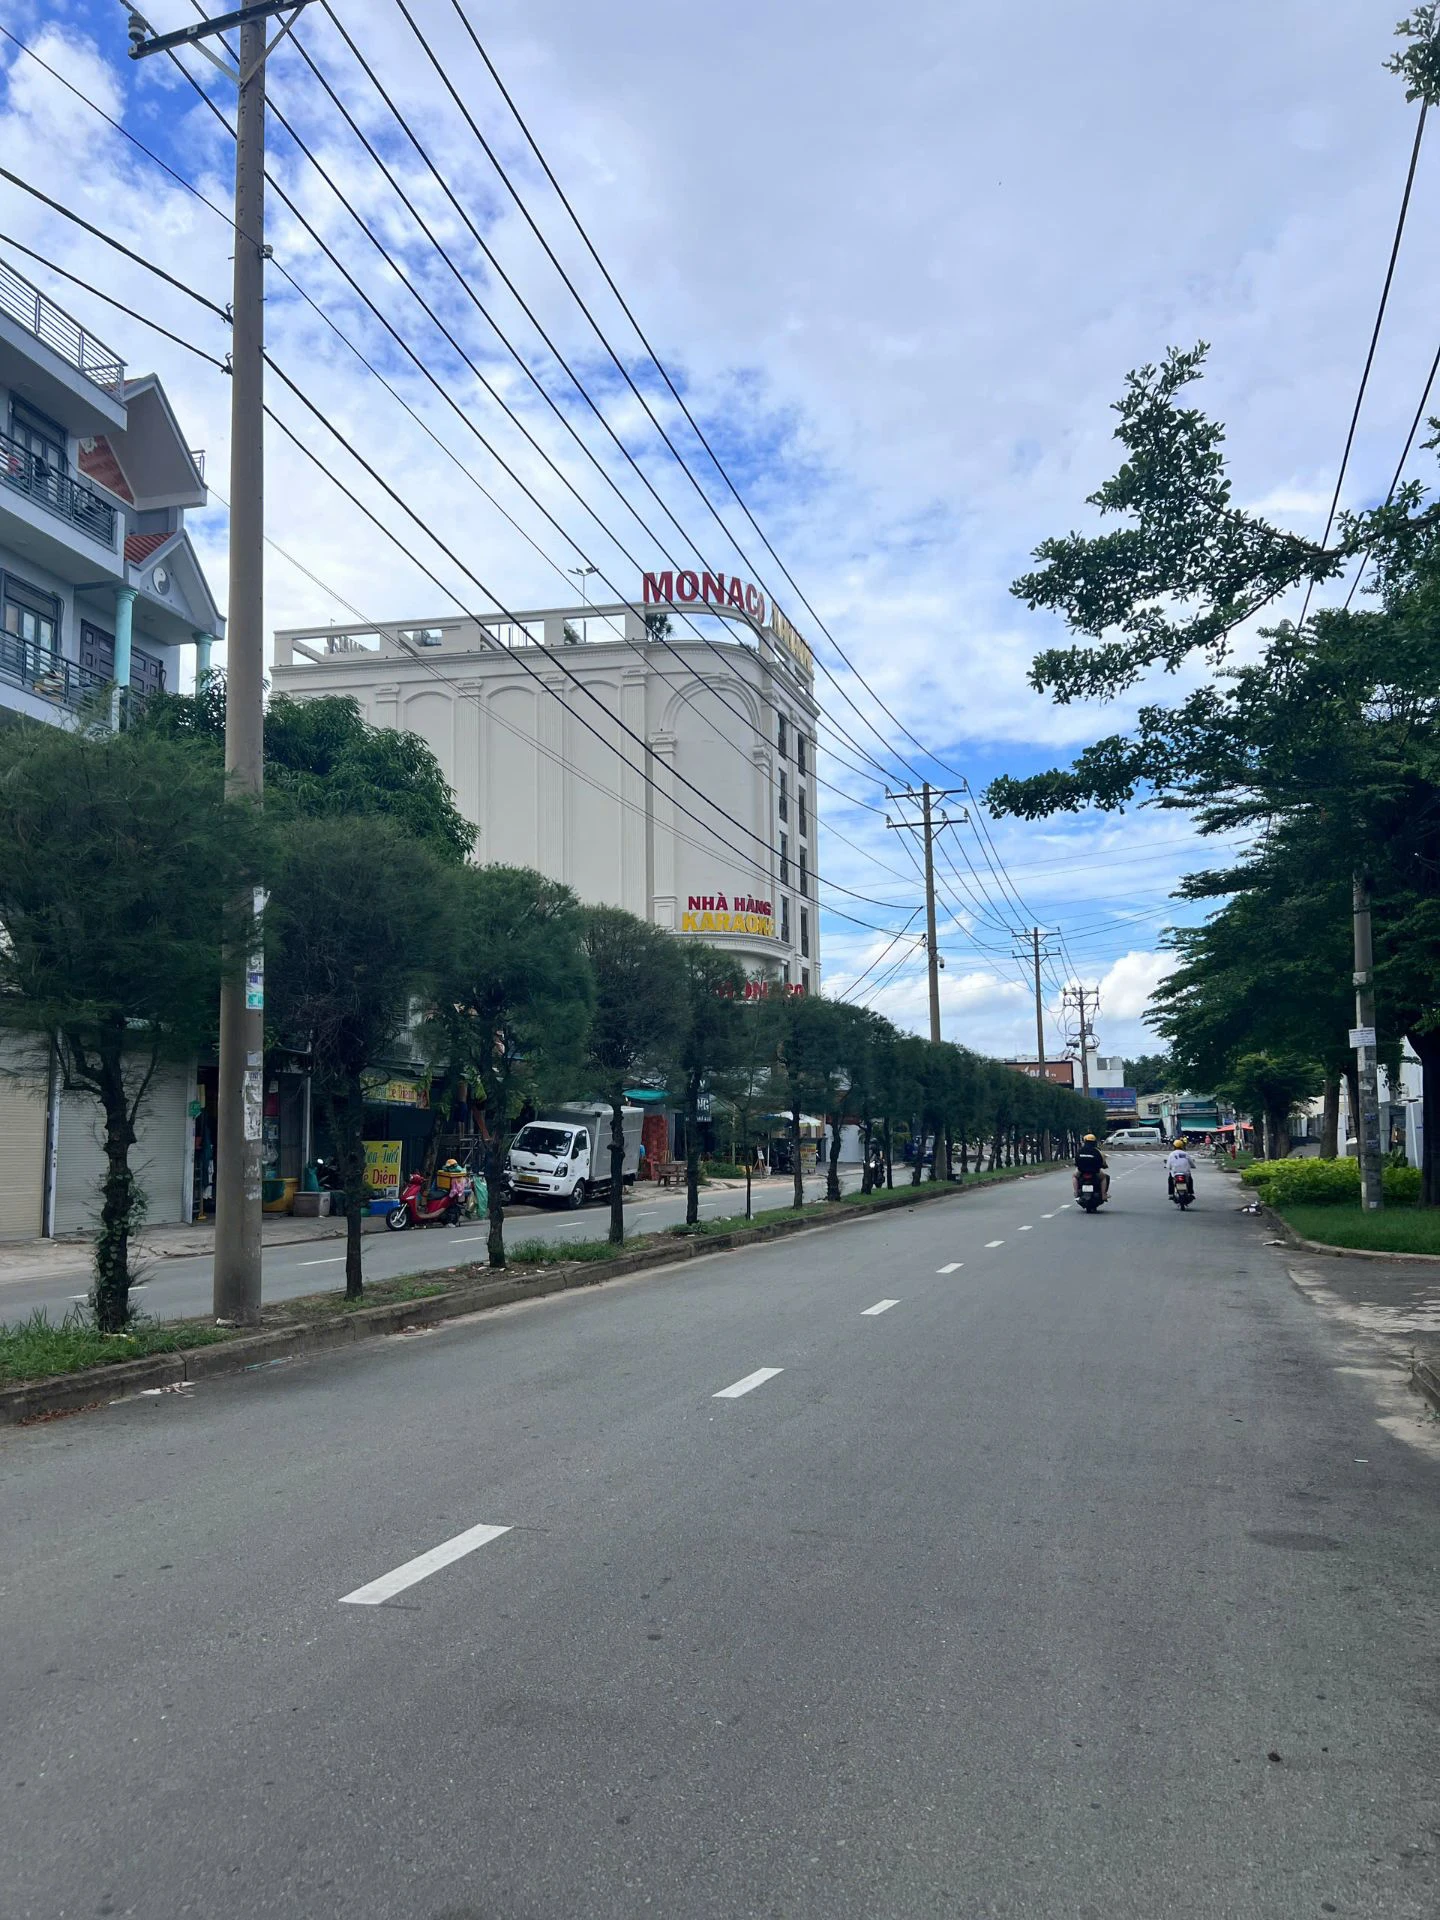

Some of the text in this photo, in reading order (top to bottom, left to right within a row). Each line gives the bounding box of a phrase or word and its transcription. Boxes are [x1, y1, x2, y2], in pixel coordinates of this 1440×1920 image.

[643, 570, 765, 624] MONACO
[688, 891, 772, 915] NHÀ HÀNG
